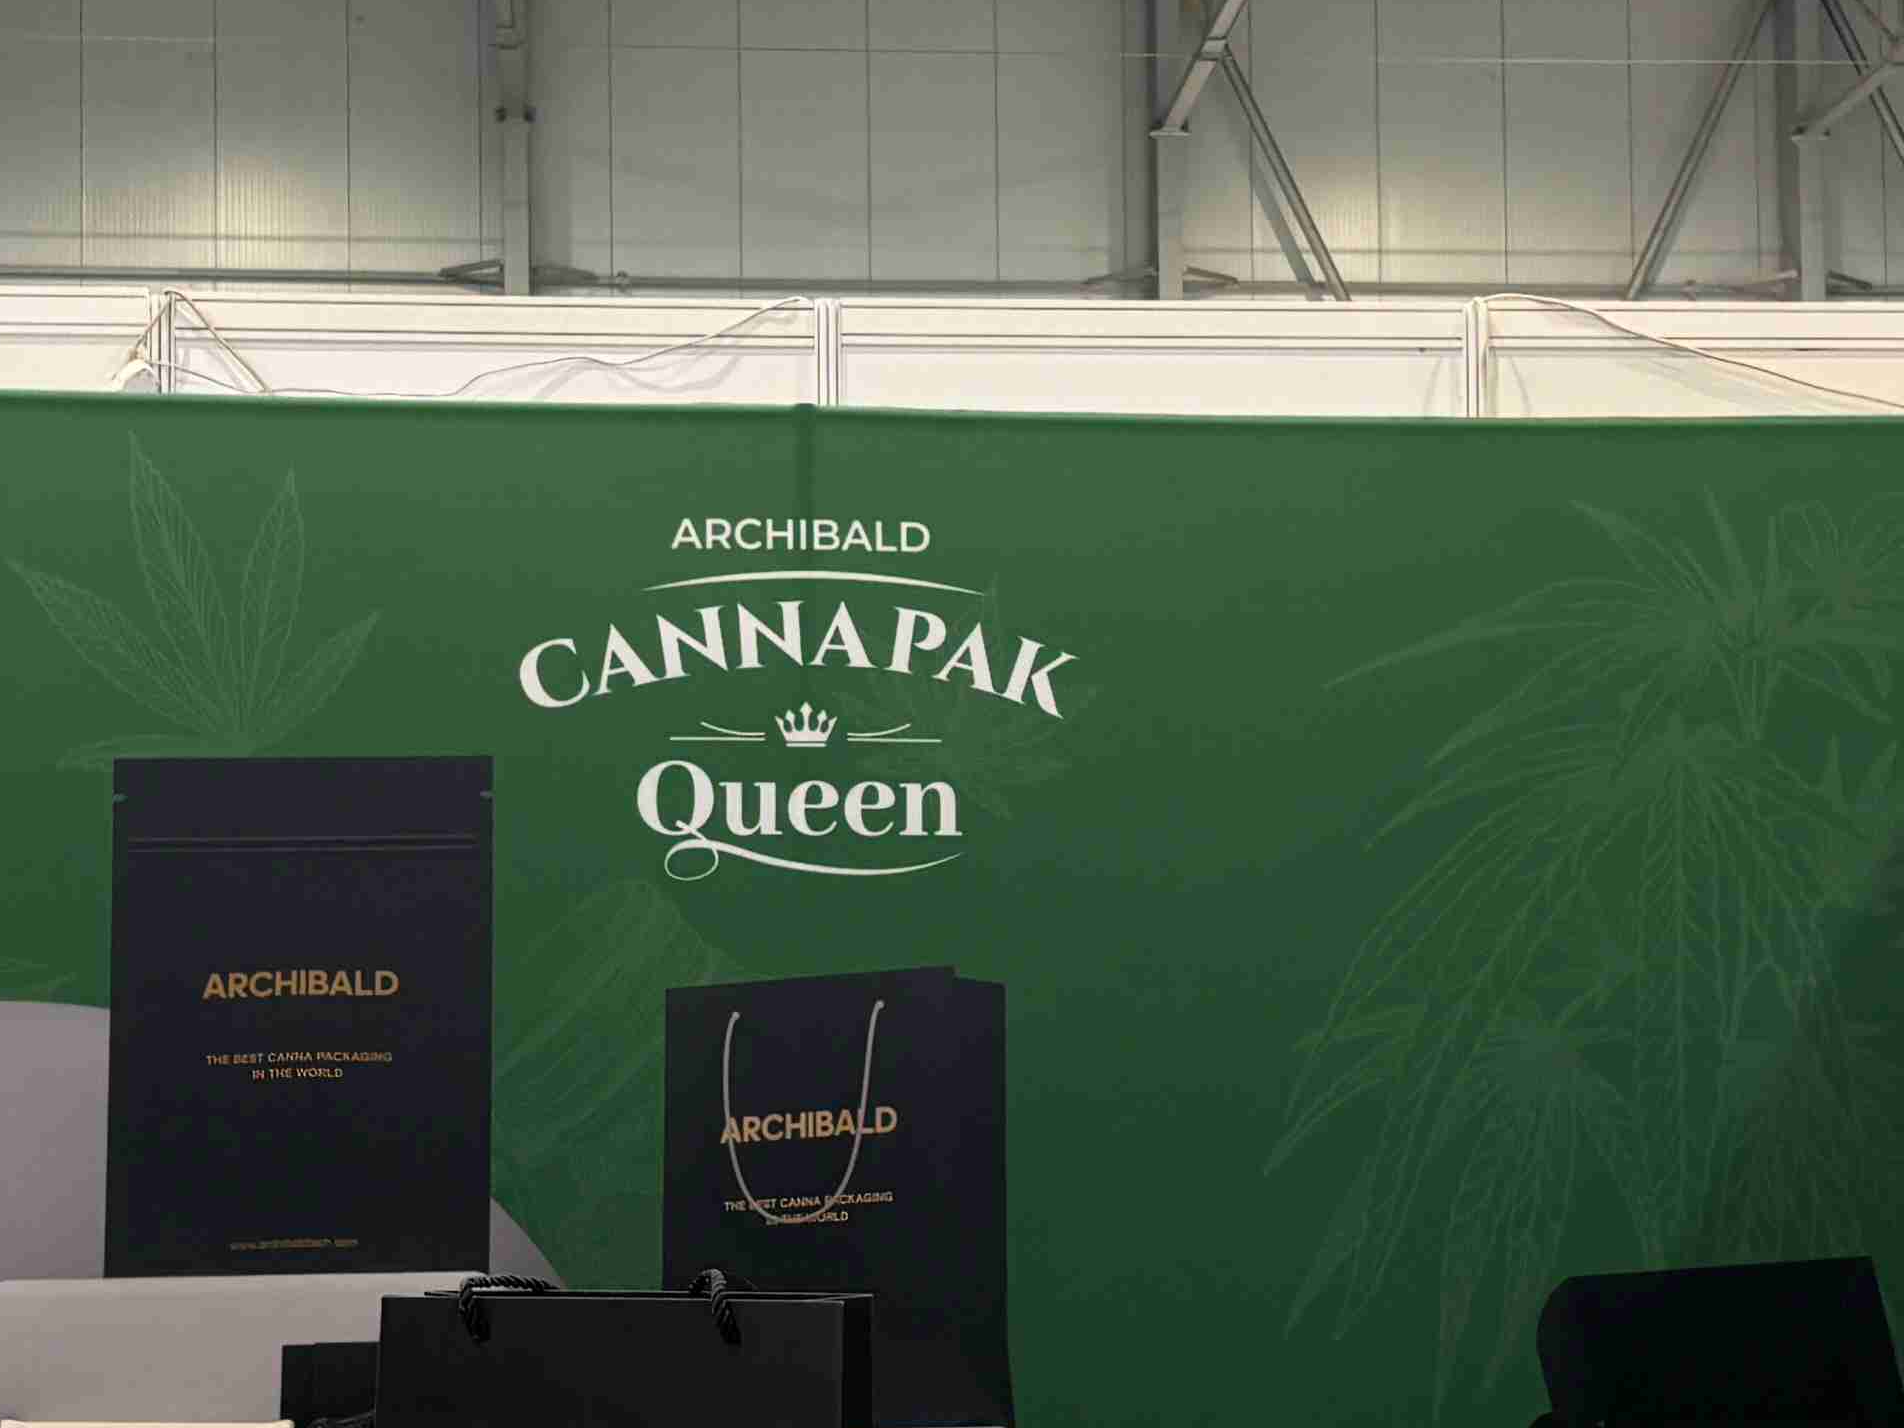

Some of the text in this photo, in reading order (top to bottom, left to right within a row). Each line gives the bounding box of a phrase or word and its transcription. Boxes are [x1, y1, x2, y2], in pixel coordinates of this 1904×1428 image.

[671, 517, 932, 553] ARCHIBALD
[636, 759, 964, 882] Queen
[202, 969, 400, 1000] ARCHIBALD
[720, 1105, 898, 1145] ARCHIBALD
